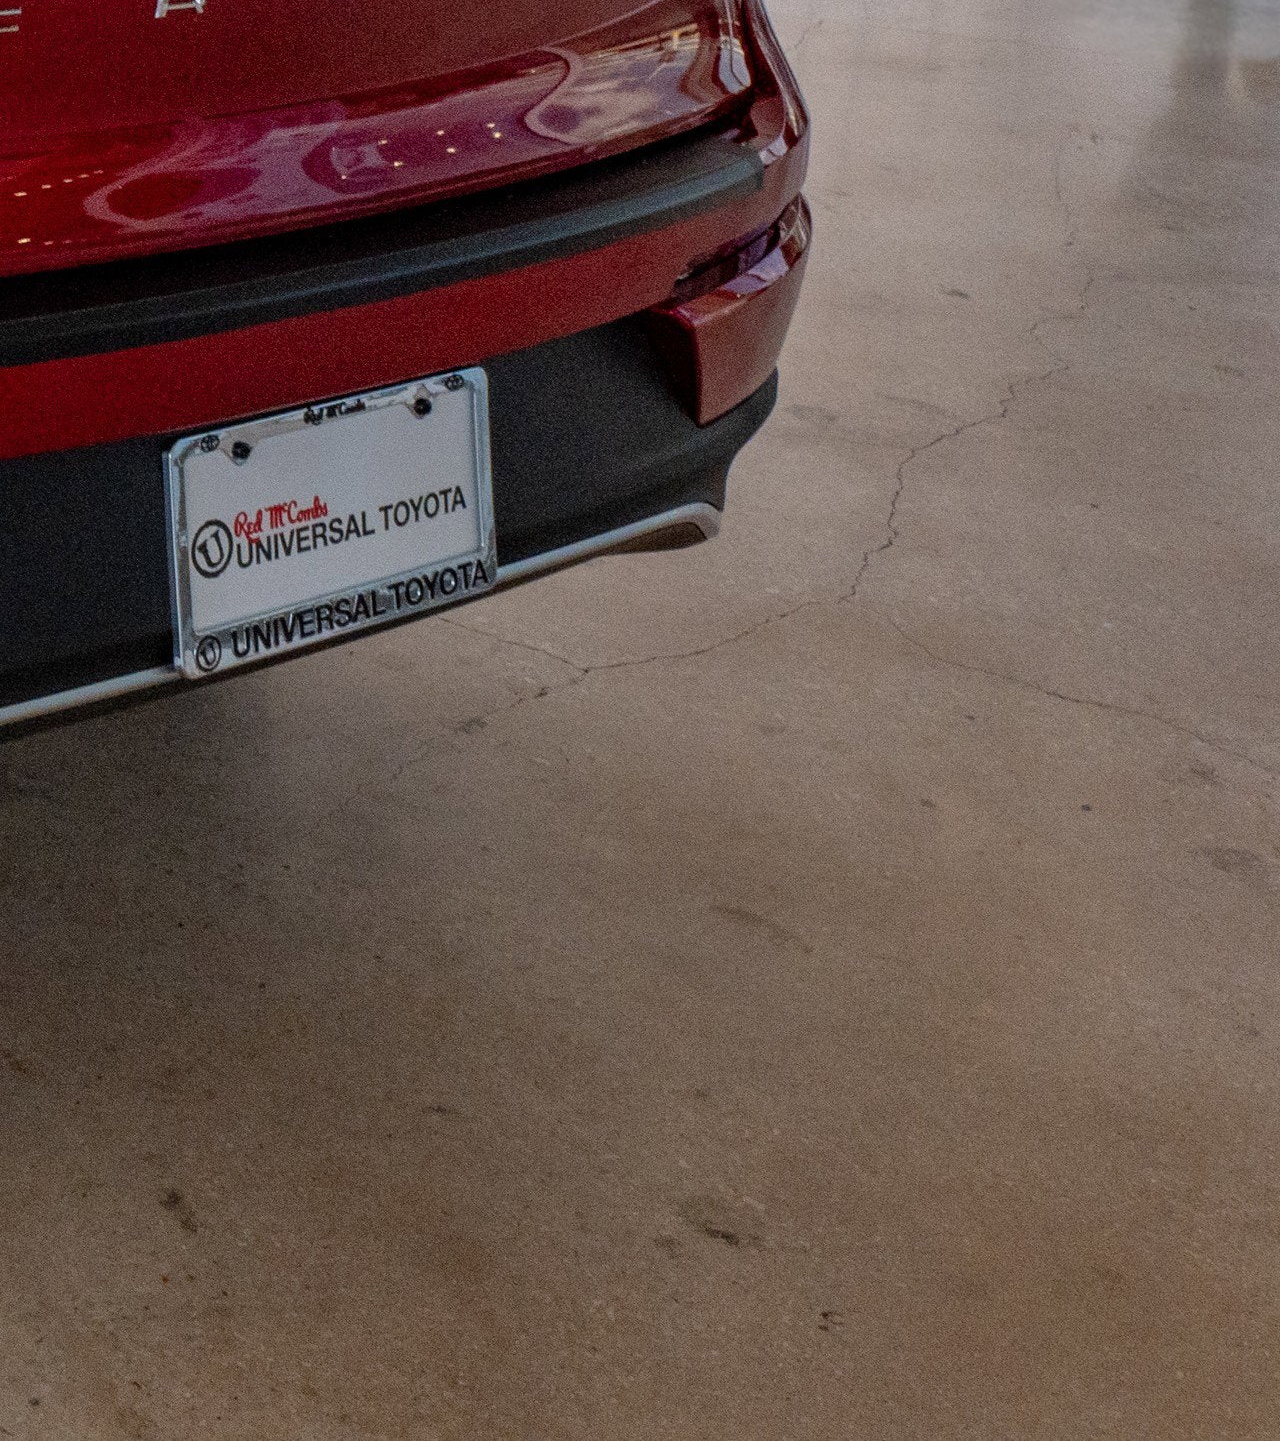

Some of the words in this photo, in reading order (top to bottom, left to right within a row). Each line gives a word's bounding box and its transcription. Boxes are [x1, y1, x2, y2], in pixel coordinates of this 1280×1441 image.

[234, 510, 263, 543] Red
[237, 511, 375, 568] UNIVERSAL
[379, 485, 467, 531] TOYOTA
[231, 589, 386, 659] UNIVERSAL
[388, 558, 490, 612] TOYOTA
